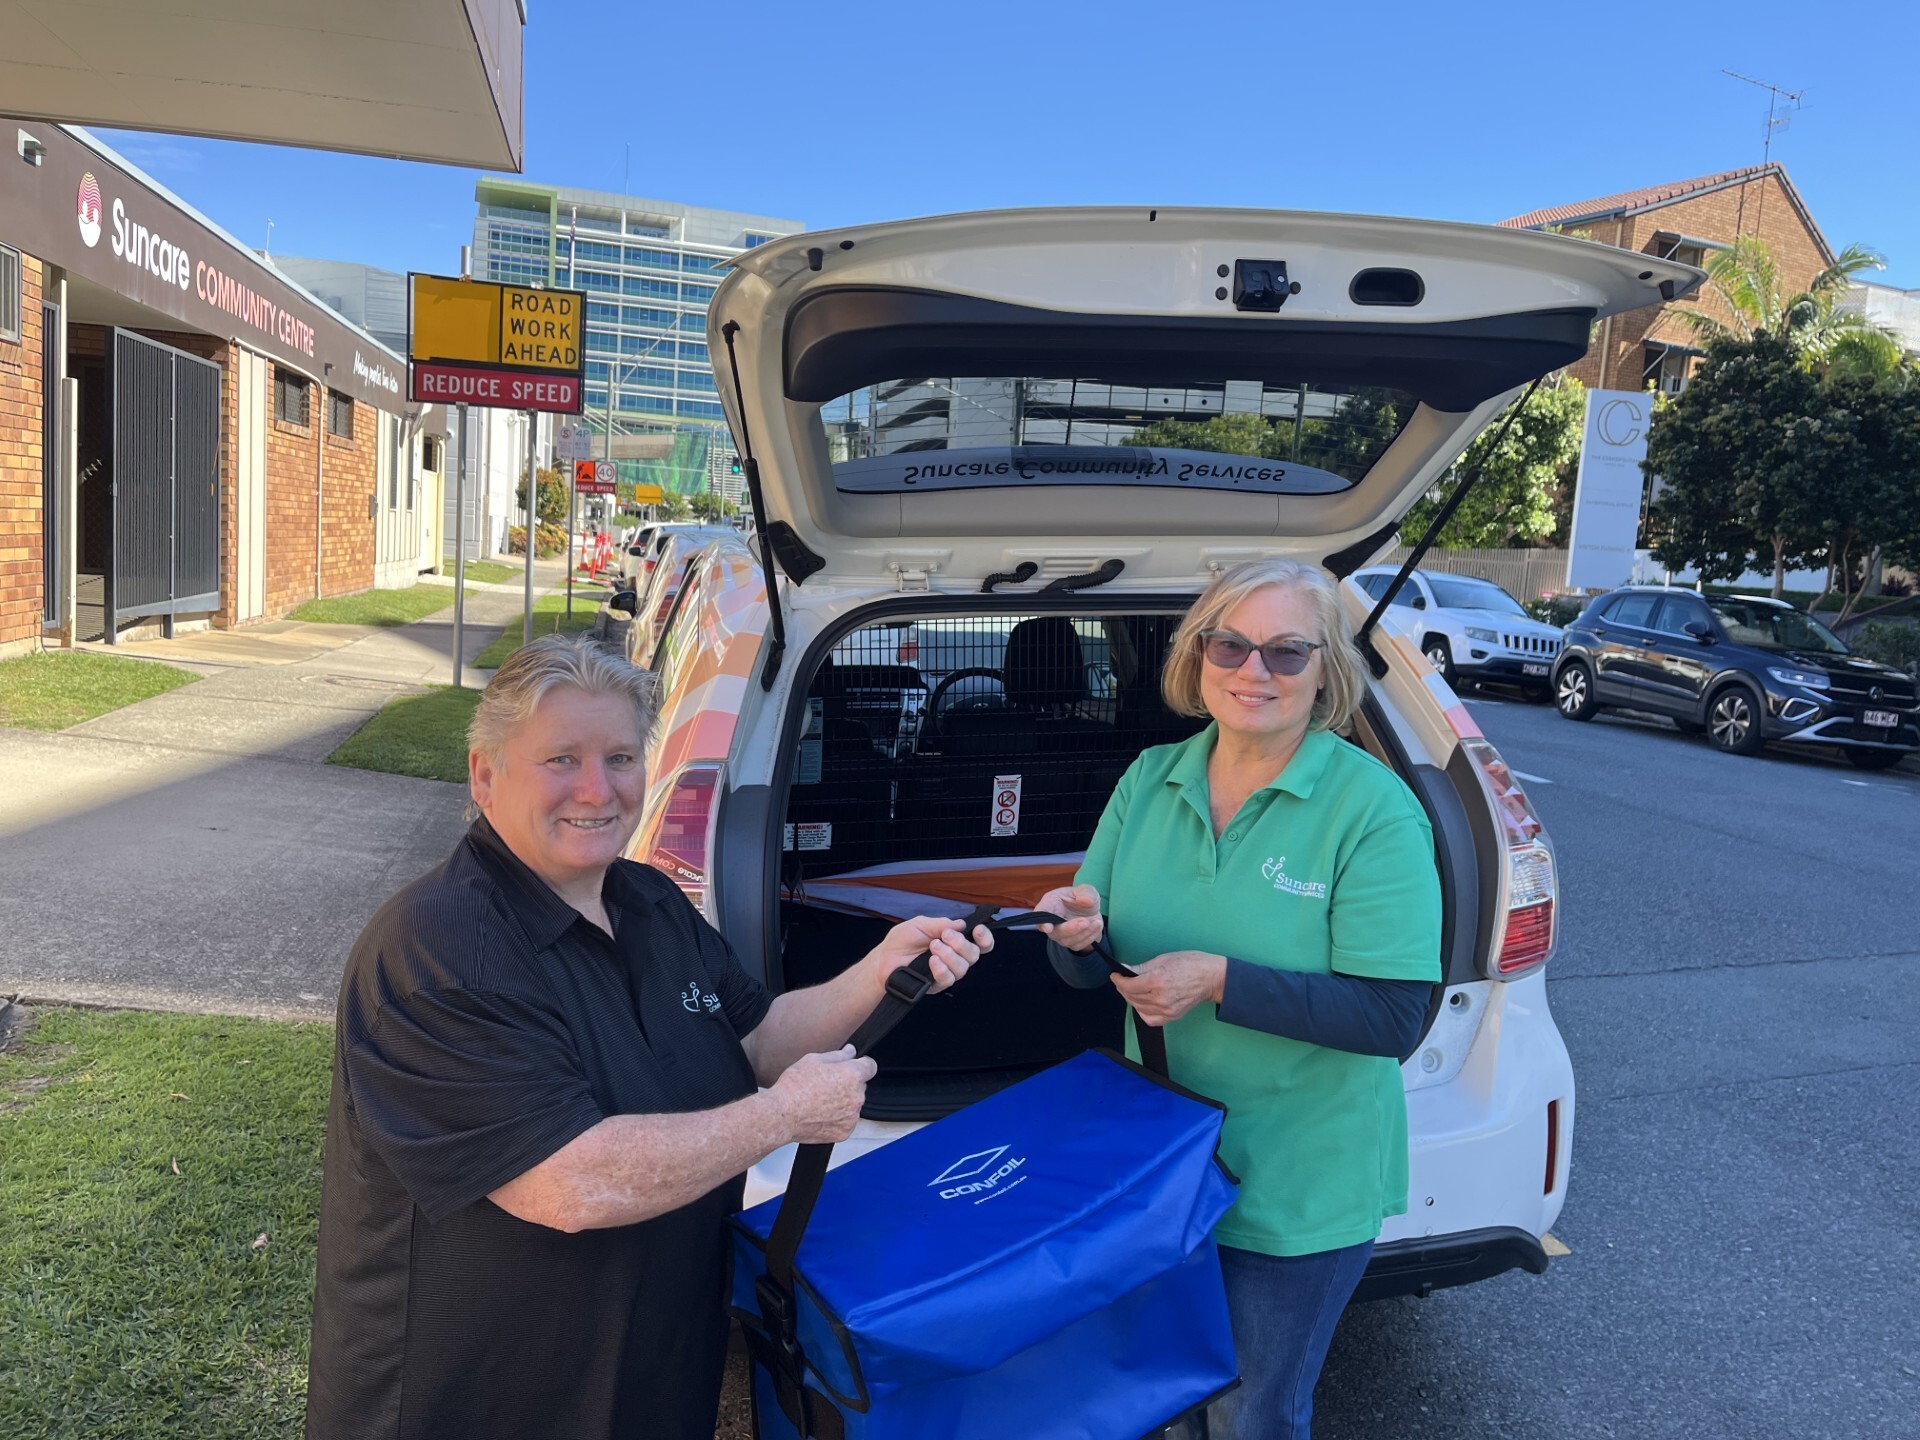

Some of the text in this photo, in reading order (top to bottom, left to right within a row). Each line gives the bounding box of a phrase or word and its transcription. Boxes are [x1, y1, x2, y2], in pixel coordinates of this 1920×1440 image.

[112, 197, 190, 291] Suncare
[196, 260, 315, 358] COMMUNITY CENTRE
[511, 293, 571, 315] ROAD
[510, 317, 571, 340] WORK
[504, 342, 577, 365] AHEAD
[423, 373, 571, 403] REDUCE SPEED
[575, 429, 590, 438] 4P
[598, 467, 613, 477] 40
[939, 1157, 1026, 1200] CONFOIL
